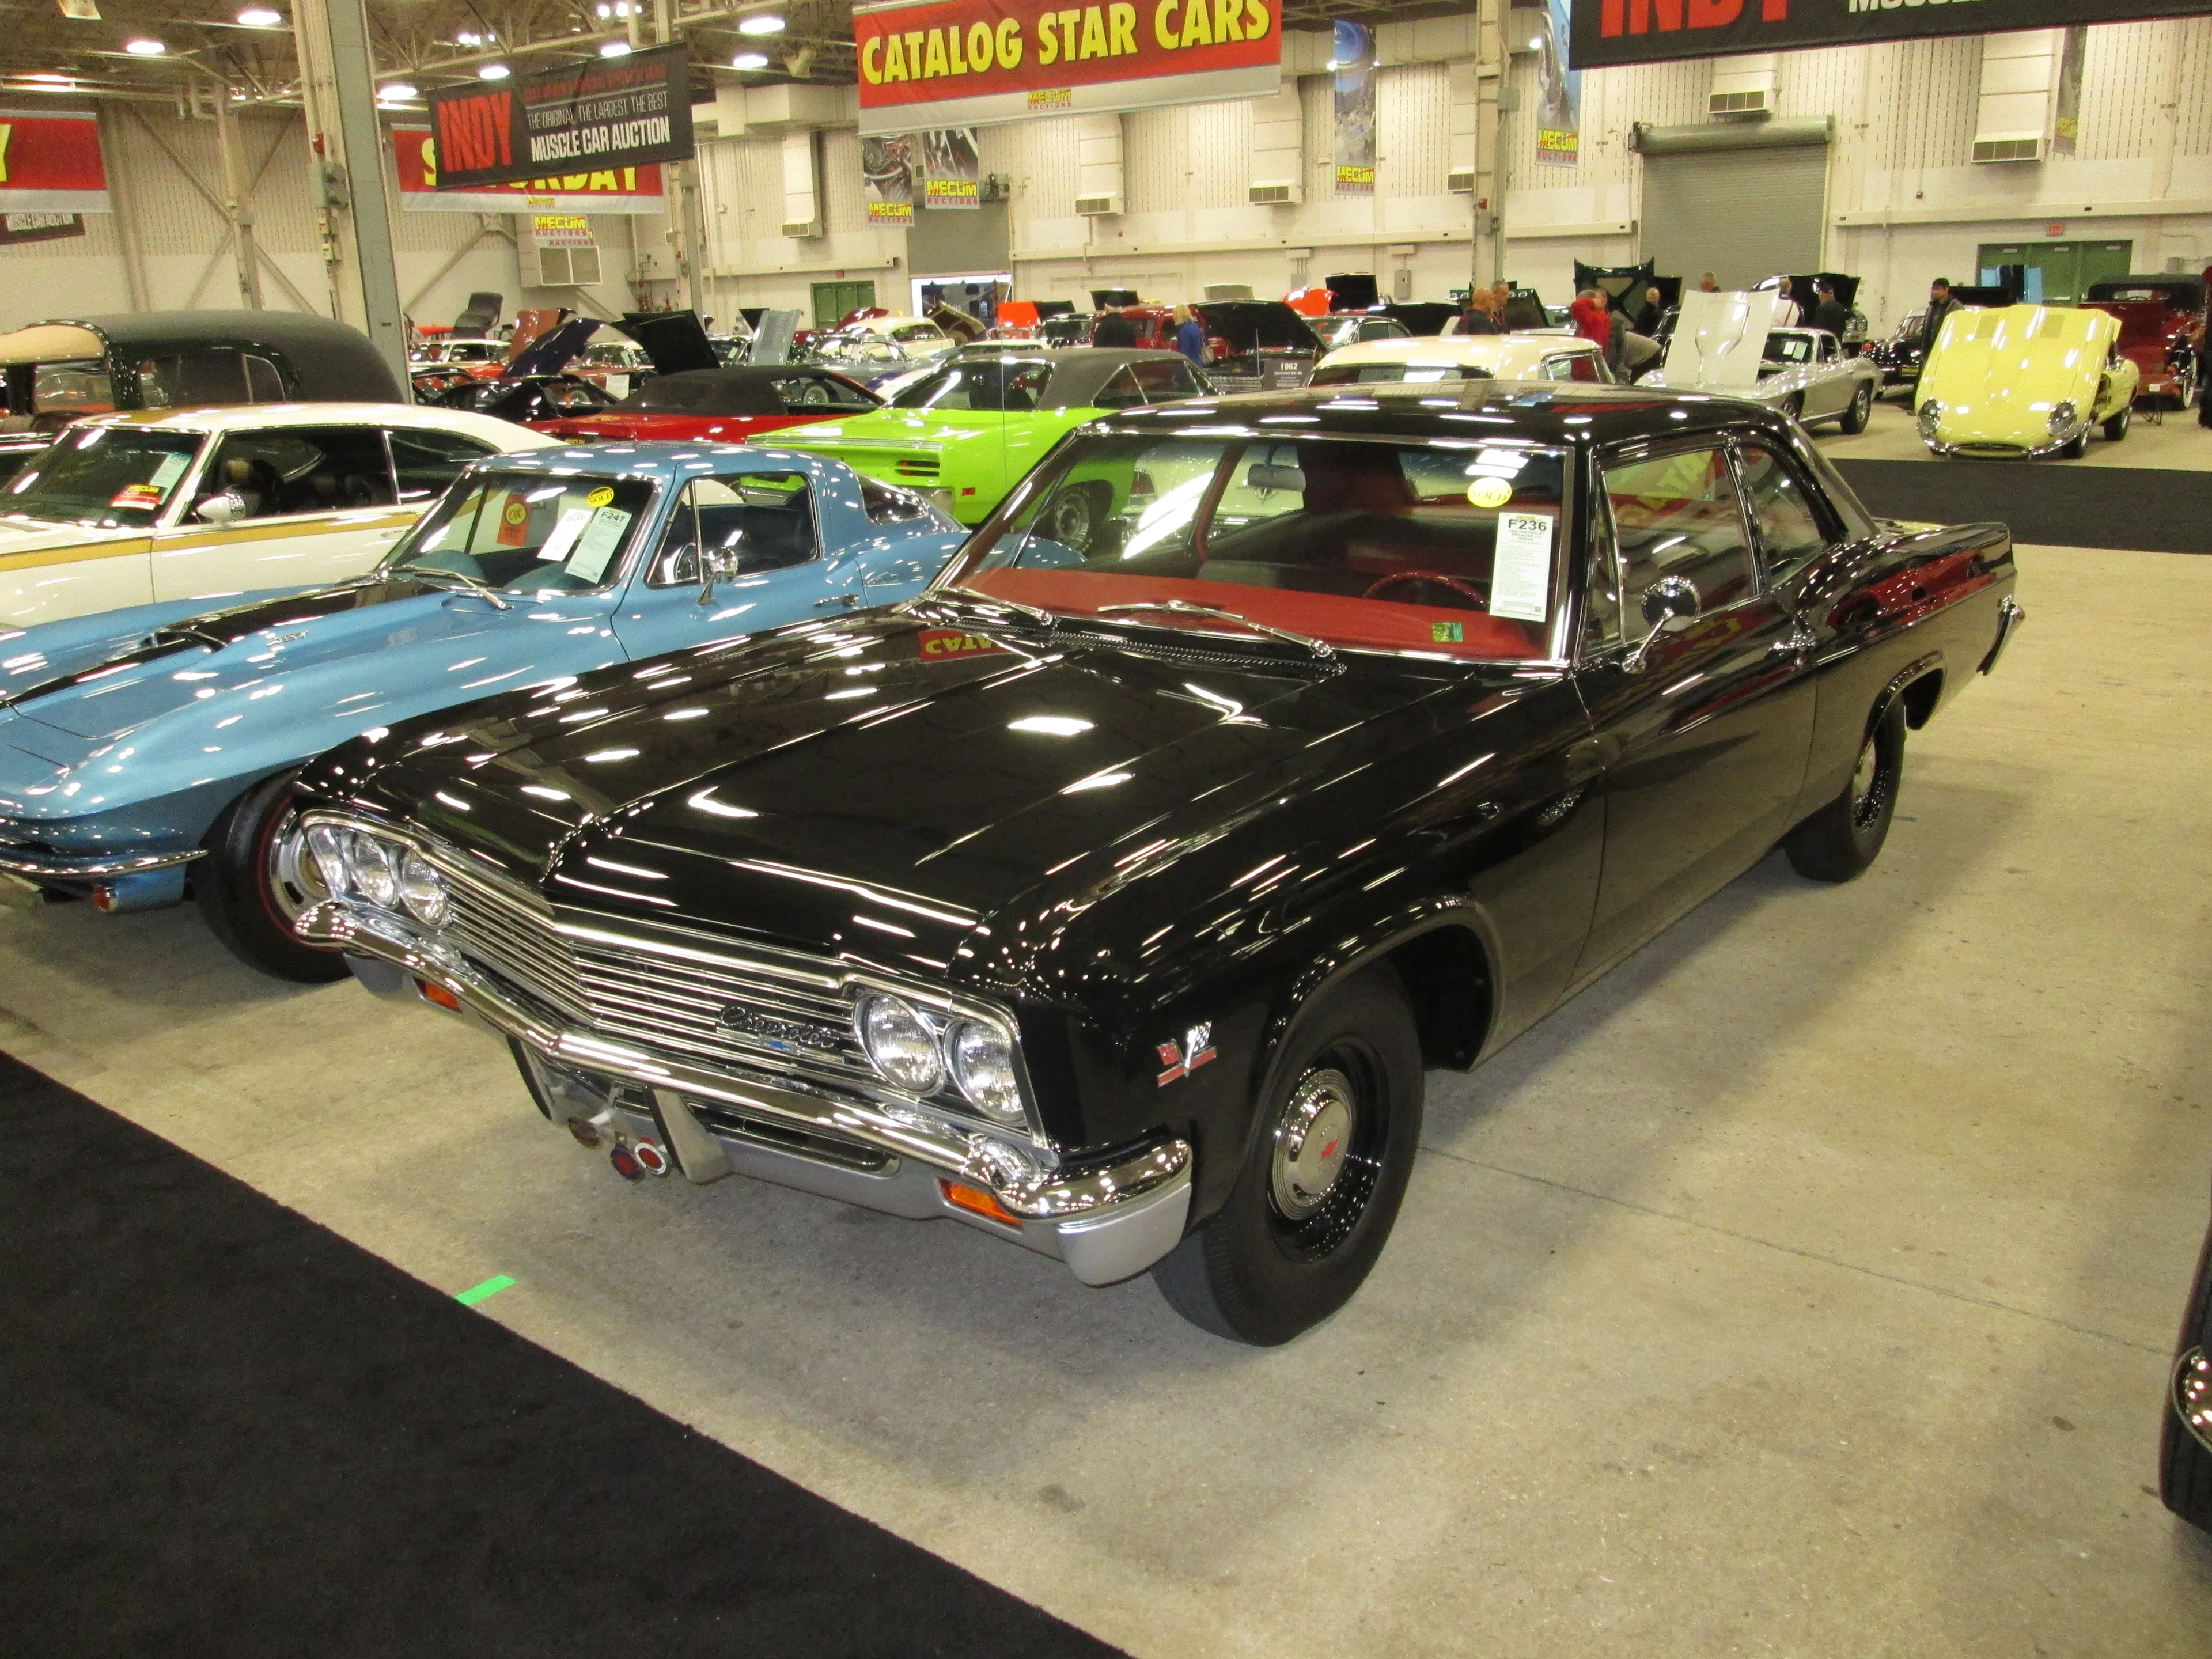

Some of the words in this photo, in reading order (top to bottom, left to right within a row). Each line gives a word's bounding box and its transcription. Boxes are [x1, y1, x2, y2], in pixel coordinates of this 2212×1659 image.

[862, 18, 1023, 85] CATALOG
[1038, 2, 1138, 65] STAR
[1154, 0, 1271, 51] CARS
[1028, 88, 1071, 103] MECUM
[527, 112, 541, 131] THE
[578, 104, 593, 122] THE
[631, 94, 646, 113] THE
[647, 90, 668, 112] BEST
[1028, 102, 1071, 111] AUCTIONS
[437, 91, 512, 172] INDY
[531, 130, 581, 162] MUSCLE
[582, 125, 610, 155] CAR
[612, 116, 671, 150] AUCTION
[1537, 128, 1577, 152] MECUM
[1336, 165, 1374, 183] MECUM
[927, 180, 978, 196] MECUM
[927, 197, 978, 205] AUCTIONS
[868, 202, 912, 217] MECUM
[535, 216, 586, 229] MECUM
[1280, 362, 1298, 370] 1962
[589, 493, 613, 504] SOLD
[1472, 490, 1508, 501] SOLD
[509, 509, 523, 520] OK
[601, 511, 626, 523] F247
[1508, 518, 1547, 532] F236
